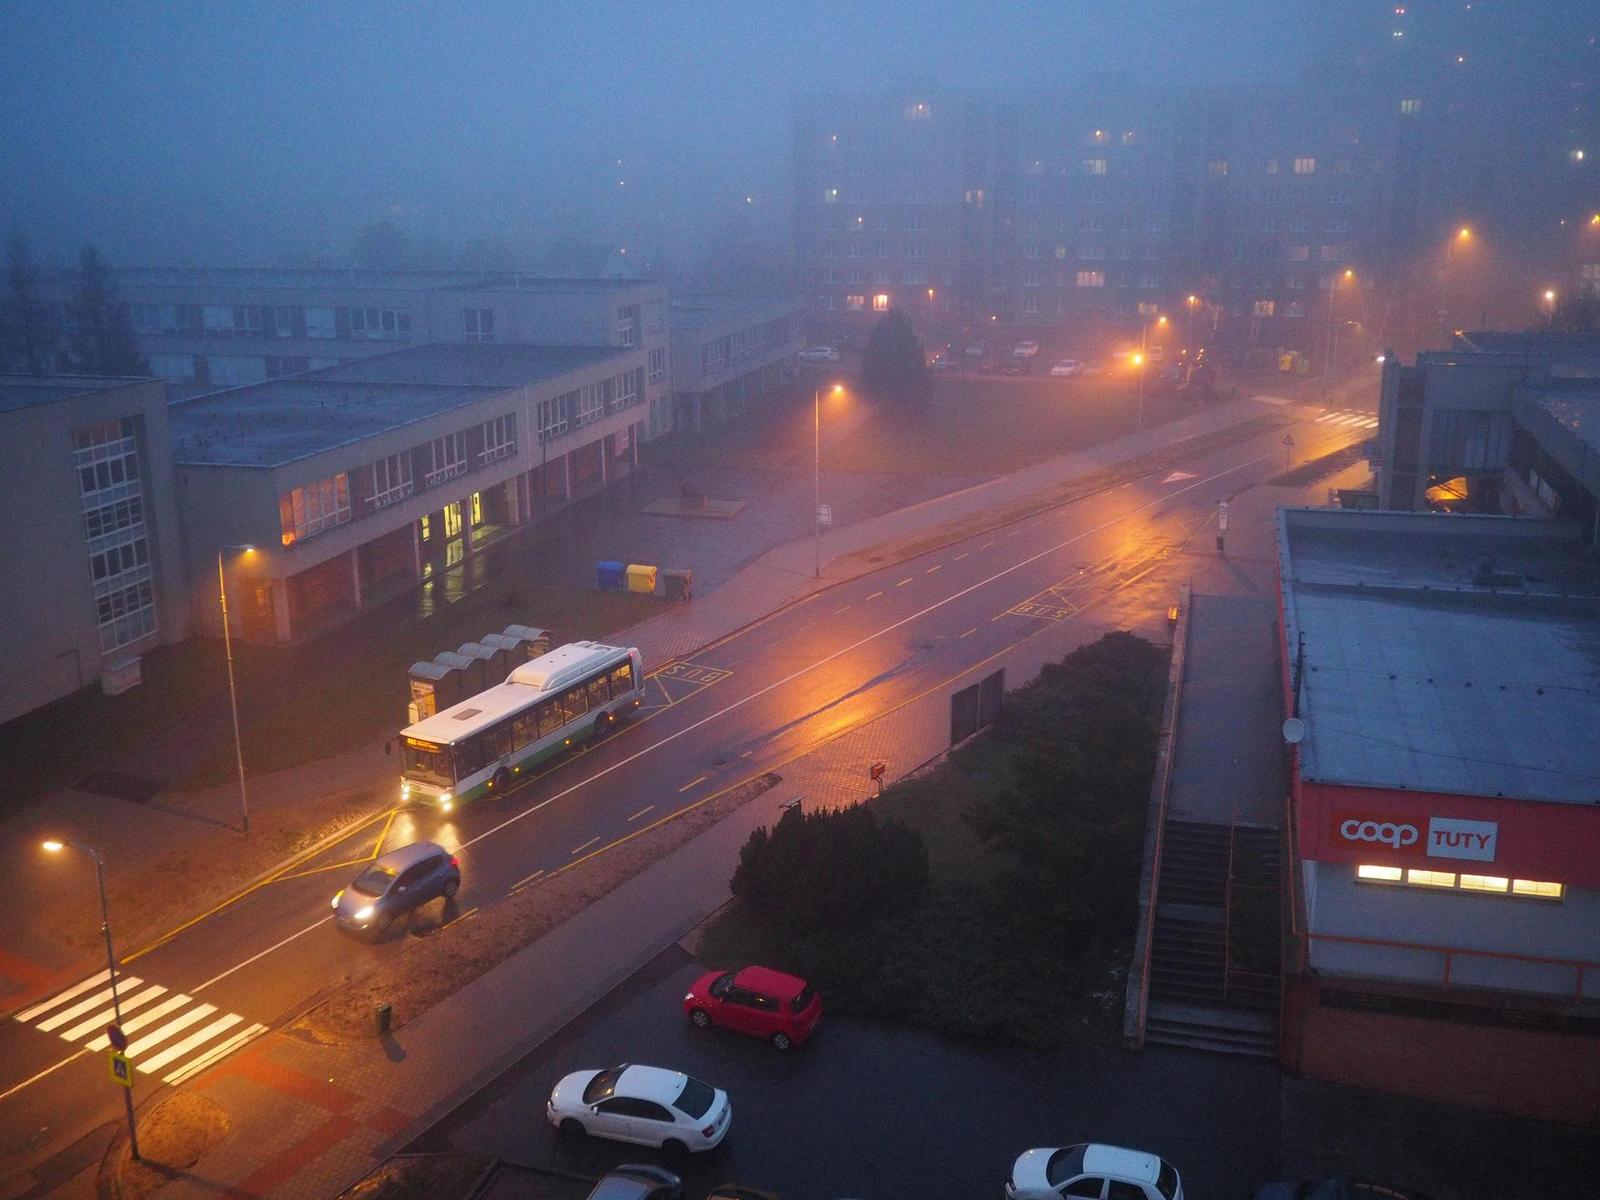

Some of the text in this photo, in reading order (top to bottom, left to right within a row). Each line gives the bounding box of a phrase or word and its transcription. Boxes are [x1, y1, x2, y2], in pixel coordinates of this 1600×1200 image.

[1015, 604, 1068, 618] BUS
[665, 665, 722, 682] BUS
[1340, 819, 1491, 849] coop TUTY
